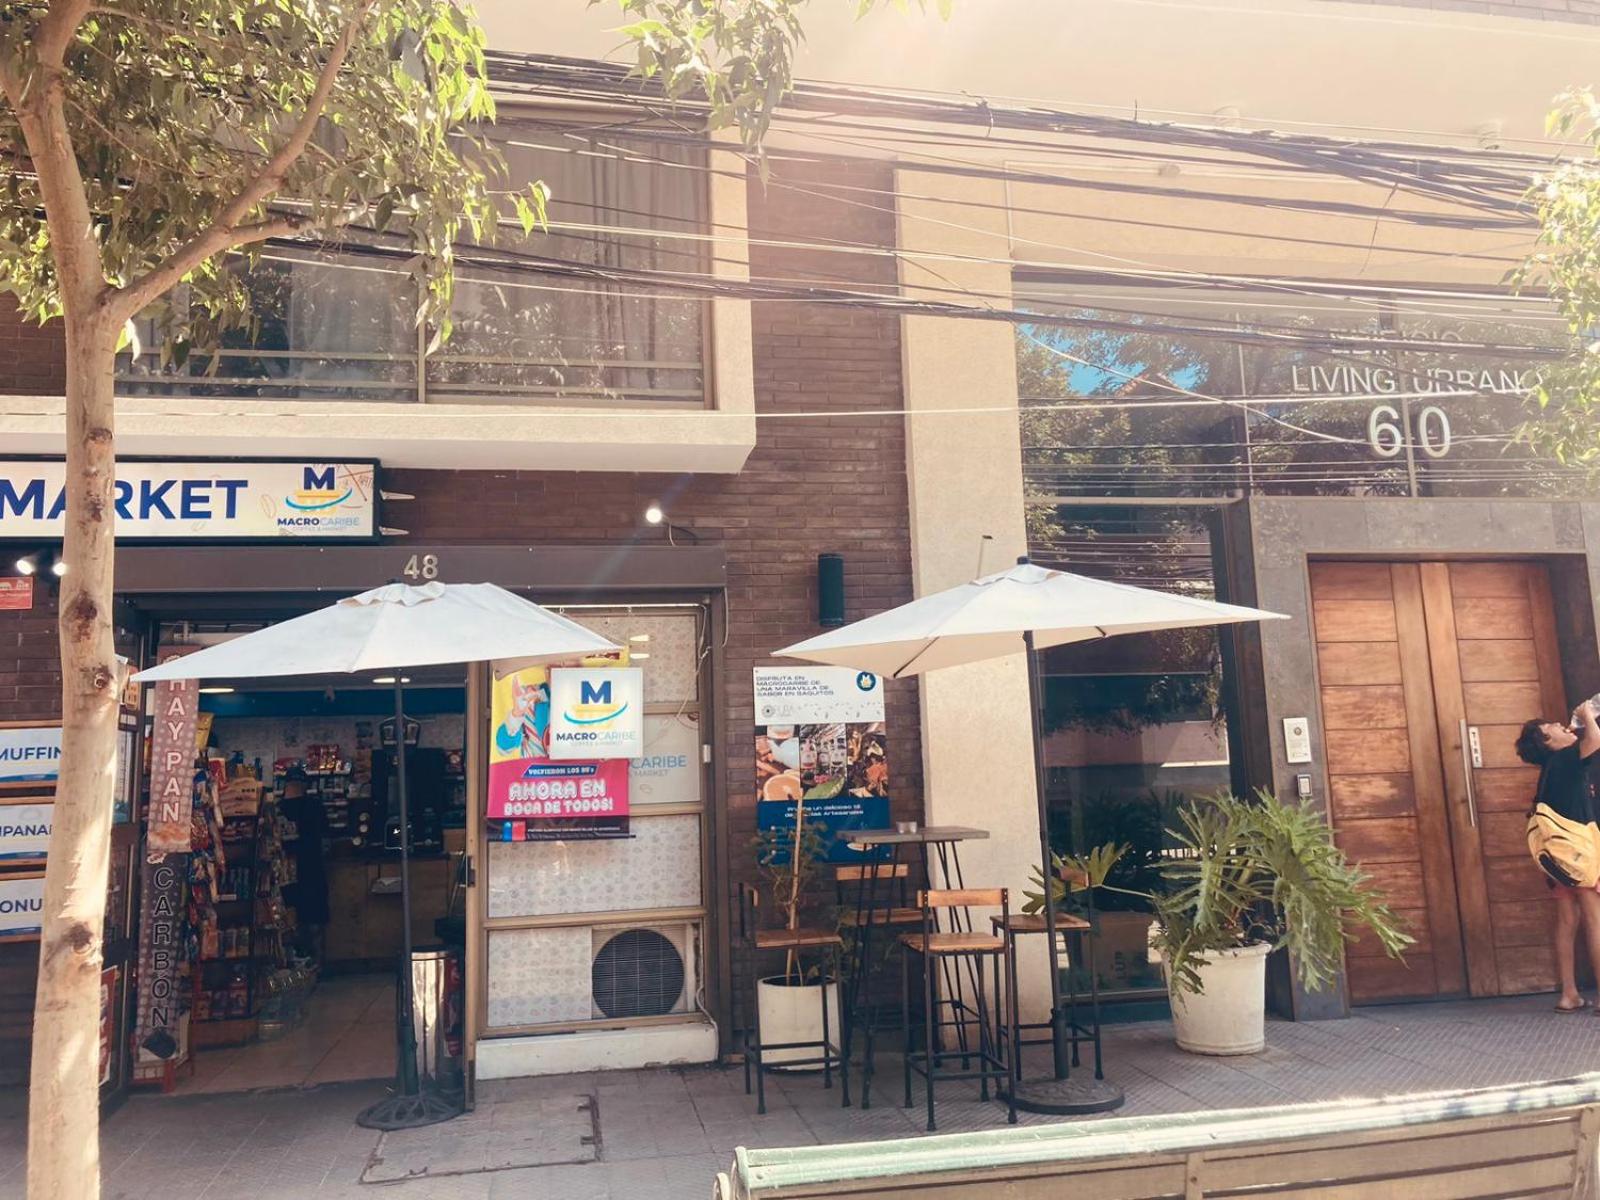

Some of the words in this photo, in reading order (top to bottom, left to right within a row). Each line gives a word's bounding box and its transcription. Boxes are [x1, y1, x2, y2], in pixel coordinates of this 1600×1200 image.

[1292, 365, 1396, 394] LIVING
[1370, 405, 1451, 457] 60
[277, 516, 360, 526] MACROCARIBE
[403, 554, 438, 579] 48
[580, 681, 611, 704] M
[631, 755, 687, 768] CARIBE
[162, 751, 182, 822] PAN
[509, 781, 577, 800] AHORA
[580, 779, 606, 798] EN
[504, 801, 542, 816] BOCA
[544, 800, 561, 814] DE
[563, 798, 613, 813] TODOS!
[0, 824, 52, 837] PANA
